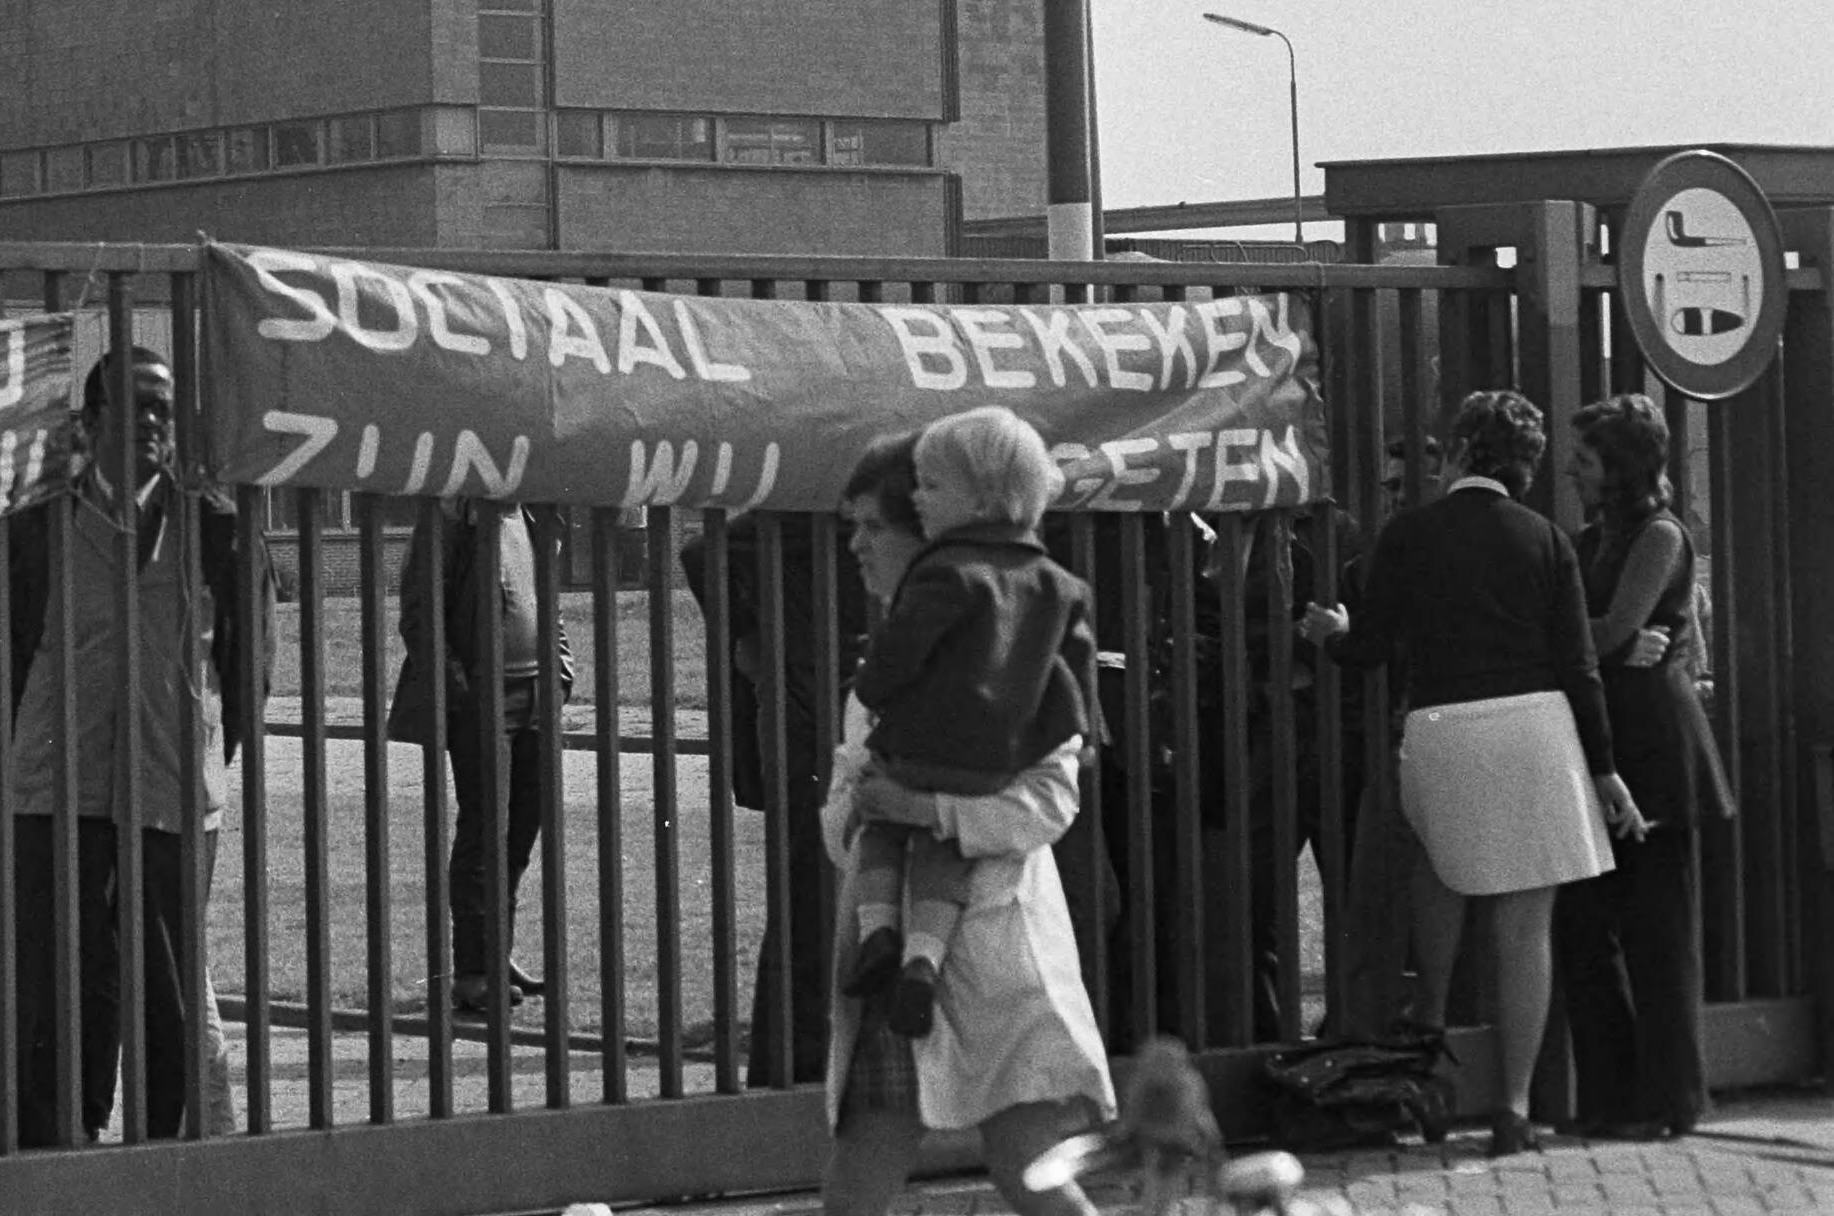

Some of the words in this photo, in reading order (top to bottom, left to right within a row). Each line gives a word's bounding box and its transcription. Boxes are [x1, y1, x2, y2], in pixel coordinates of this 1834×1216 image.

[247, 249, 753, 382] SOCIAAL
[880, 292, 1302, 392] BEKEKEN
[256, 410, 530, 499] ZIJN
[622, 439, 780, 520] WIJ
